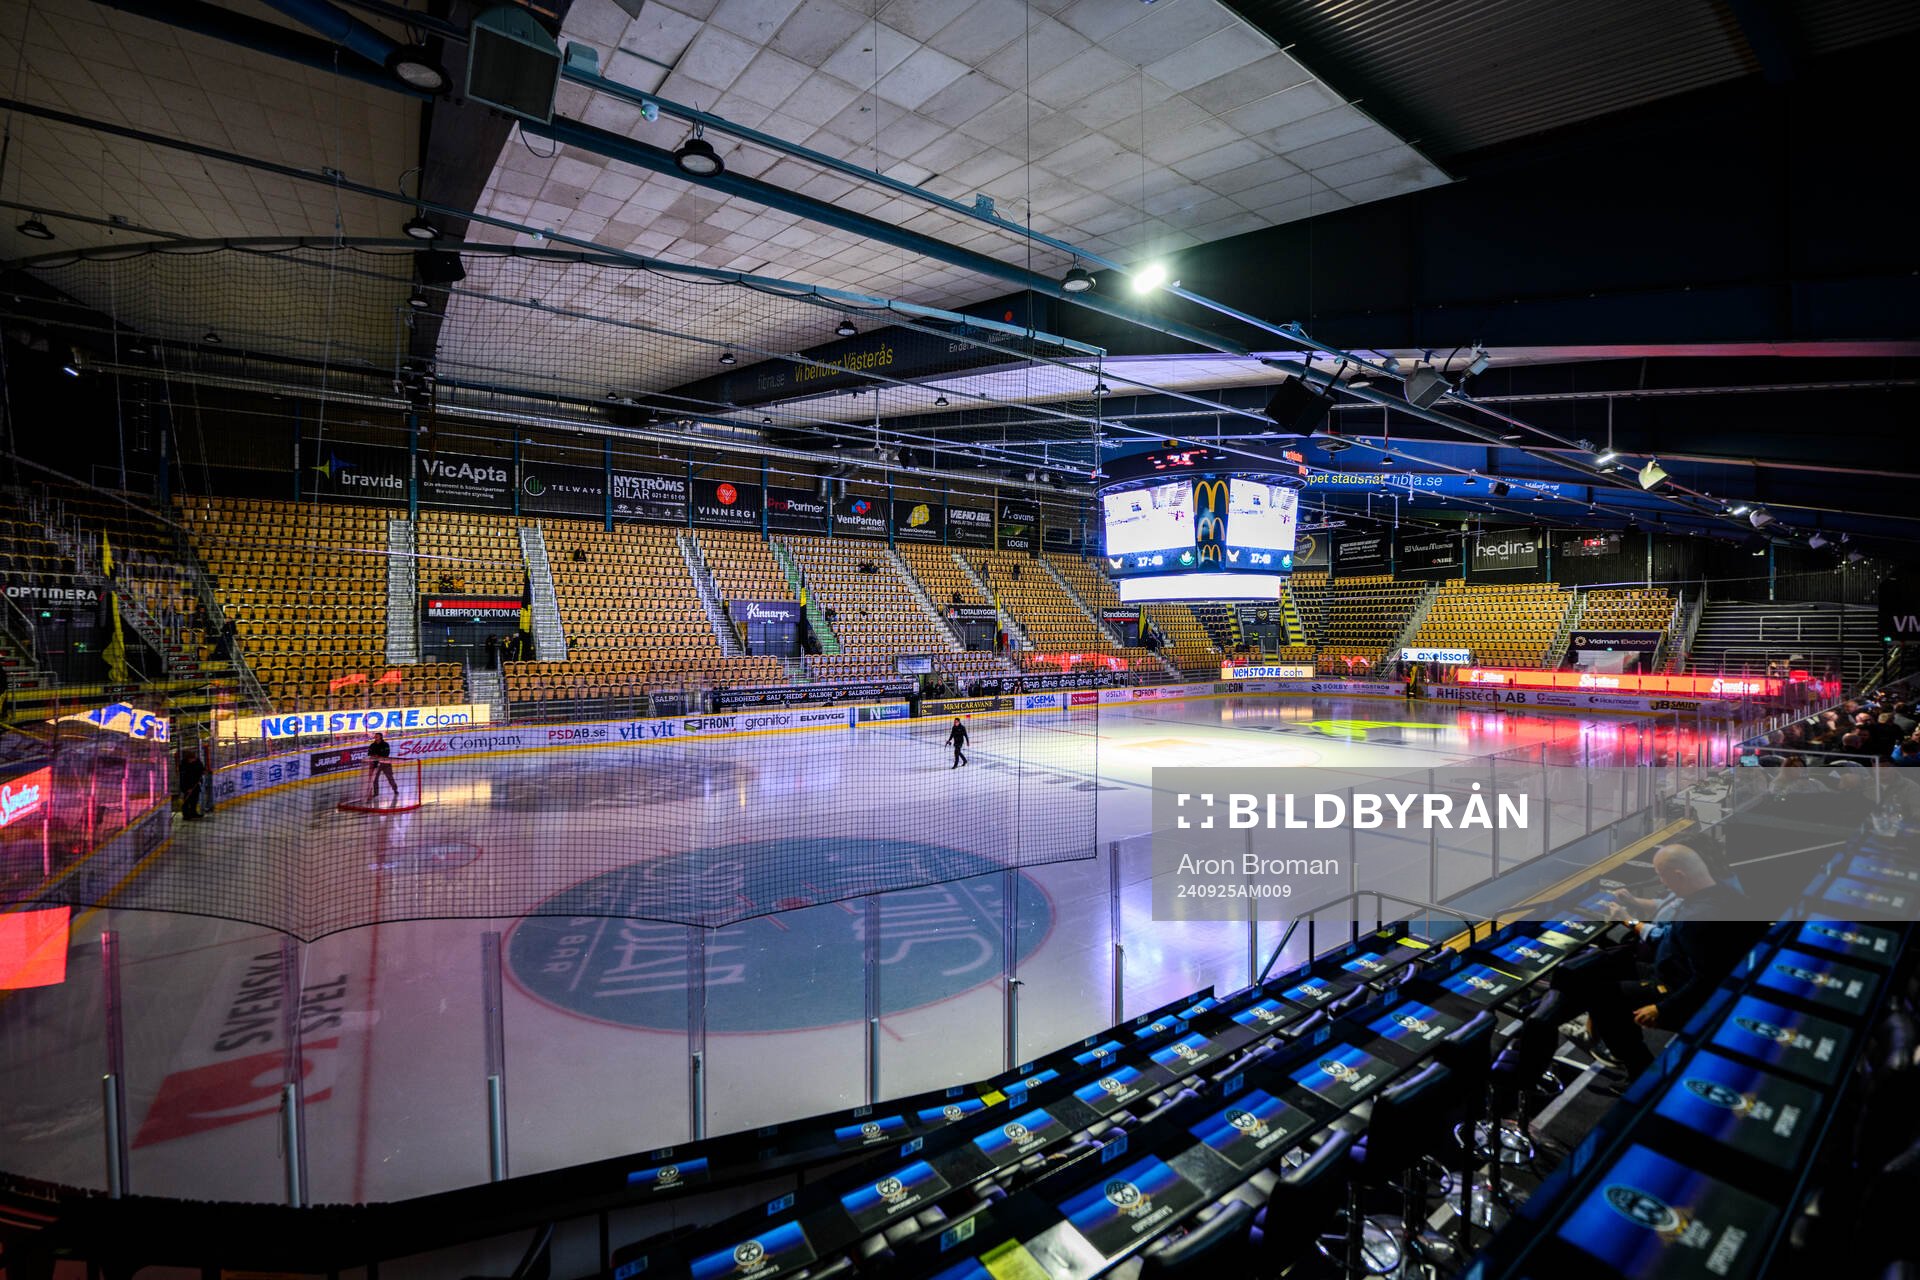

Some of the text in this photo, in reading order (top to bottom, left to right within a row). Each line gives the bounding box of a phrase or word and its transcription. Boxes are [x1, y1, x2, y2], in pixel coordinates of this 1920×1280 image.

[794, 365, 803, 382] Vi
[844, 343, 893, 372] Västerås
[422, 459, 507, 484] VicApta
[341, 470, 403, 489] bravida
[613, 475, 685, 492] NYSTRÖMS
[1306, 475, 1328, 486] pet
[552, 484, 602, 495] TELWAYS
[613, 487, 650, 500] BILAR
[698, 506, 756, 519] VINNERGI
[837, 514, 886, 527] VentPartner
[1007, 539, 1028, 548] LOGEN
[1476, 539, 1534, 558] hedins
[7, 586, 98, 601] OPTIMERA
[747, 602, 791, 621] Kinnarps
[1588, 637, 1619, 645] Vidman
[1417, 651, 1470, 661] axelsson
[1034, 695, 1056, 704] GEMA
[1445, 688, 1501, 701] Hisstech
[1505, 691, 1526, 703] AB
[703, 717, 736, 730] FRONT
[745, 714, 790, 731] granitor
[800, 712, 845, 722] ELVBYGG
[548, 728, 606, 740] PSDAB.se
[618, 721, 675, 740] vlt vlt
[398, 734, 521, 757] Skills Company
[315, 755, 341, 767] JUMP
[214, 948, 288, 1051] SVENSKA
